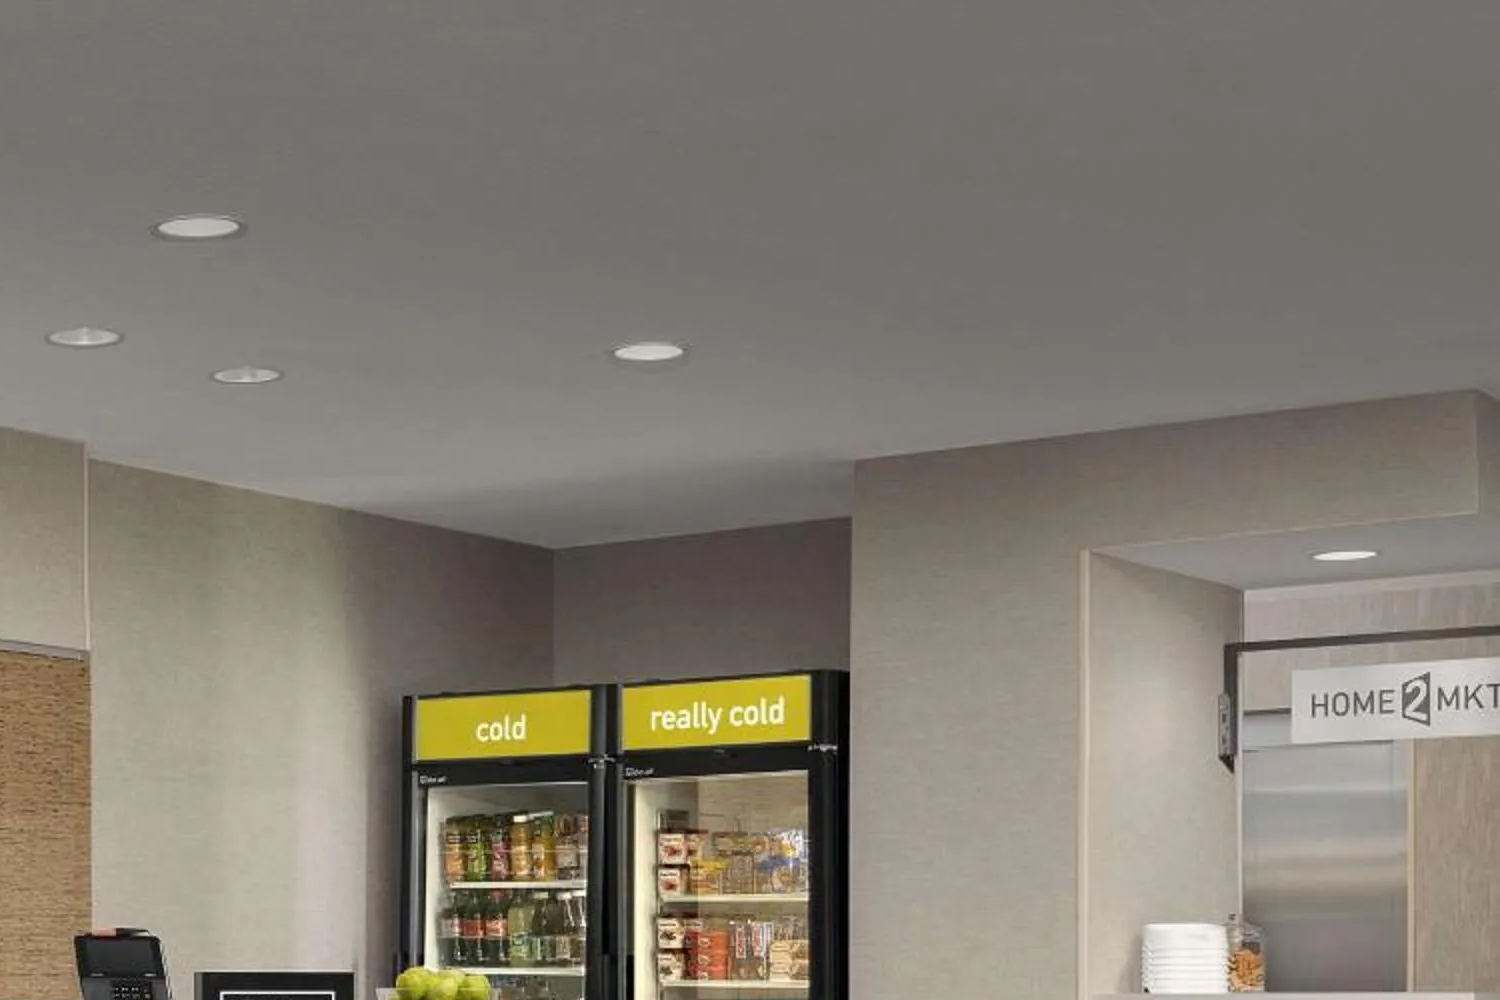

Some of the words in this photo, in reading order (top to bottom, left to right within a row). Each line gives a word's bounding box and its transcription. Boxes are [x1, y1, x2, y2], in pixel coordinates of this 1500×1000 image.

[475, 714, 527, 742] cold
[650, 700, 723, 735] really
[728, 695, 786, 727] cold
